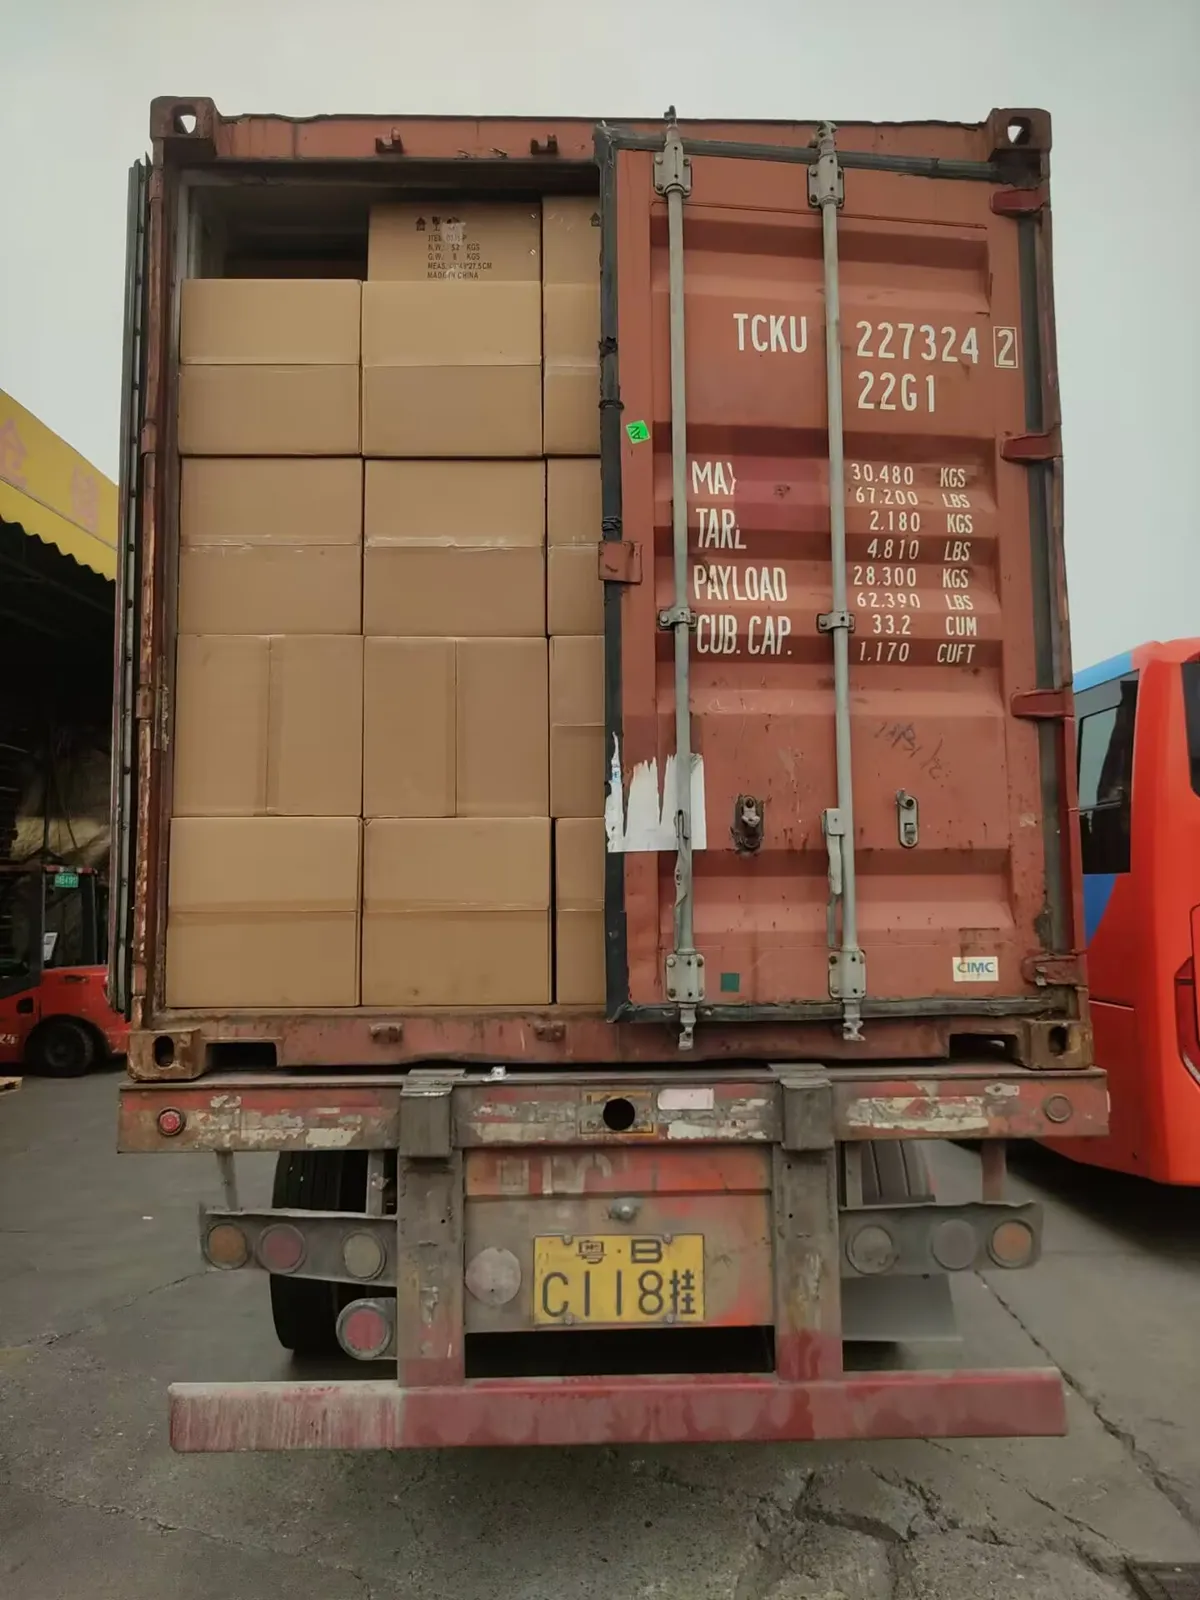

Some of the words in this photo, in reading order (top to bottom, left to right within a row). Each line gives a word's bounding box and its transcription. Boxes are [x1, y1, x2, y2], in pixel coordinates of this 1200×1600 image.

[466, 243, 480, 251] KGS
[466, 253, 480, 261] KGS
[457, 271, 479, 279] CHINA
[734, 314, 806, 352] TCKU
[857, 321, 978, 363] 227324
[996, 330, 1016, 365] 2
[858, 371, 934, 412] 22G1
[852, 464, 913, 484] 30.480
[941, 468, 965, 487] KGS
[856, 487, 918, 505] 67.200
[942, 494, 970, 508] LBS
[870, 511, 920, 531] 2.180
[948, 514, 973, 533] KGS
[867, 539, 919, 559] 4.810
[944, 541, 970, 561] LBS
[694, 566, 787, 601] PAYLOAD
[854, 566, 916, 586] 28.300
[943, 569, 968, 588] KGS
[857, 593, 920, 608] 62.390
[945, 595, 973, 610] LBS
[698, 615, 740, 653] CUB.
[749, 616, 791, 654] CAP.
[873, 614, 910, 634] 33.2
[946, 617, 976, 635] CUM
[937, 644, 975, 663] CUFT
[957, 962, 994, 973] CIMC
